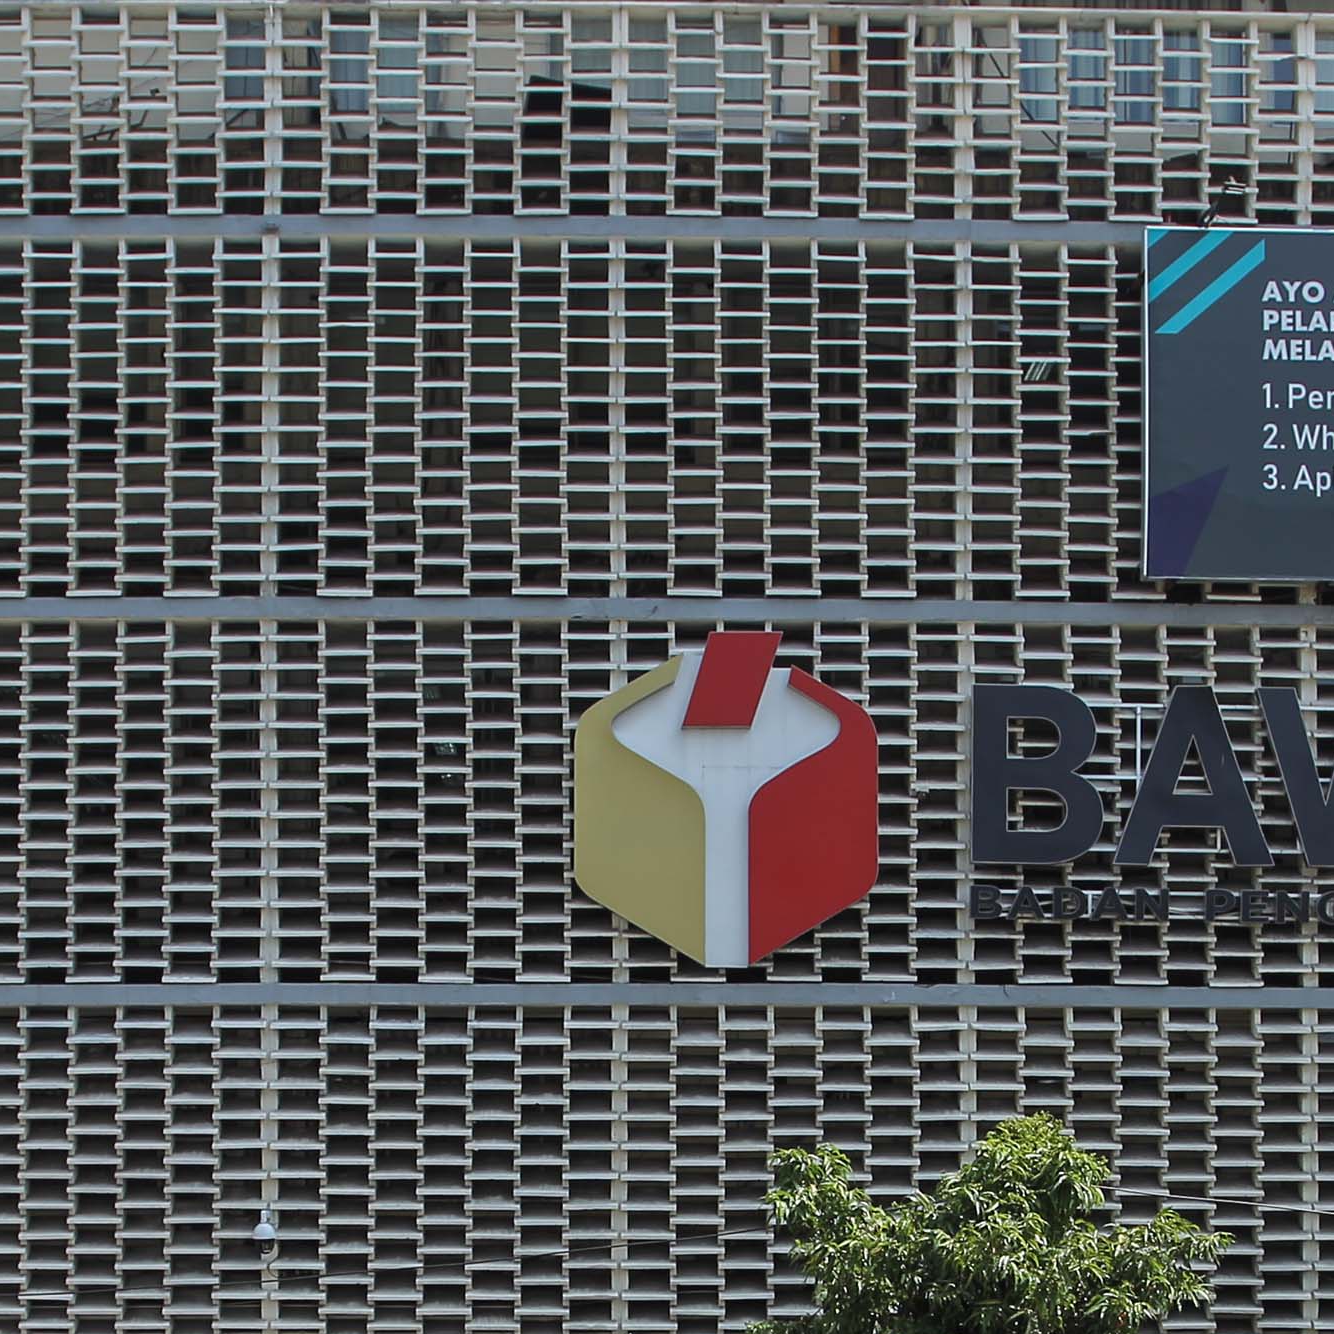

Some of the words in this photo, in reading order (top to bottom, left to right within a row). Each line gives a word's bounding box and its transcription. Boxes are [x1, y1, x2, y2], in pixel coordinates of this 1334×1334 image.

[1261, 281, 1325, 304] AYO
[1261, 383, 1280, 409] 1.
[1262, 424, 1286, 450] 2.
[1262, 464, 1286, 491] 3.
[968, 884, 1169, 922] BADAN
